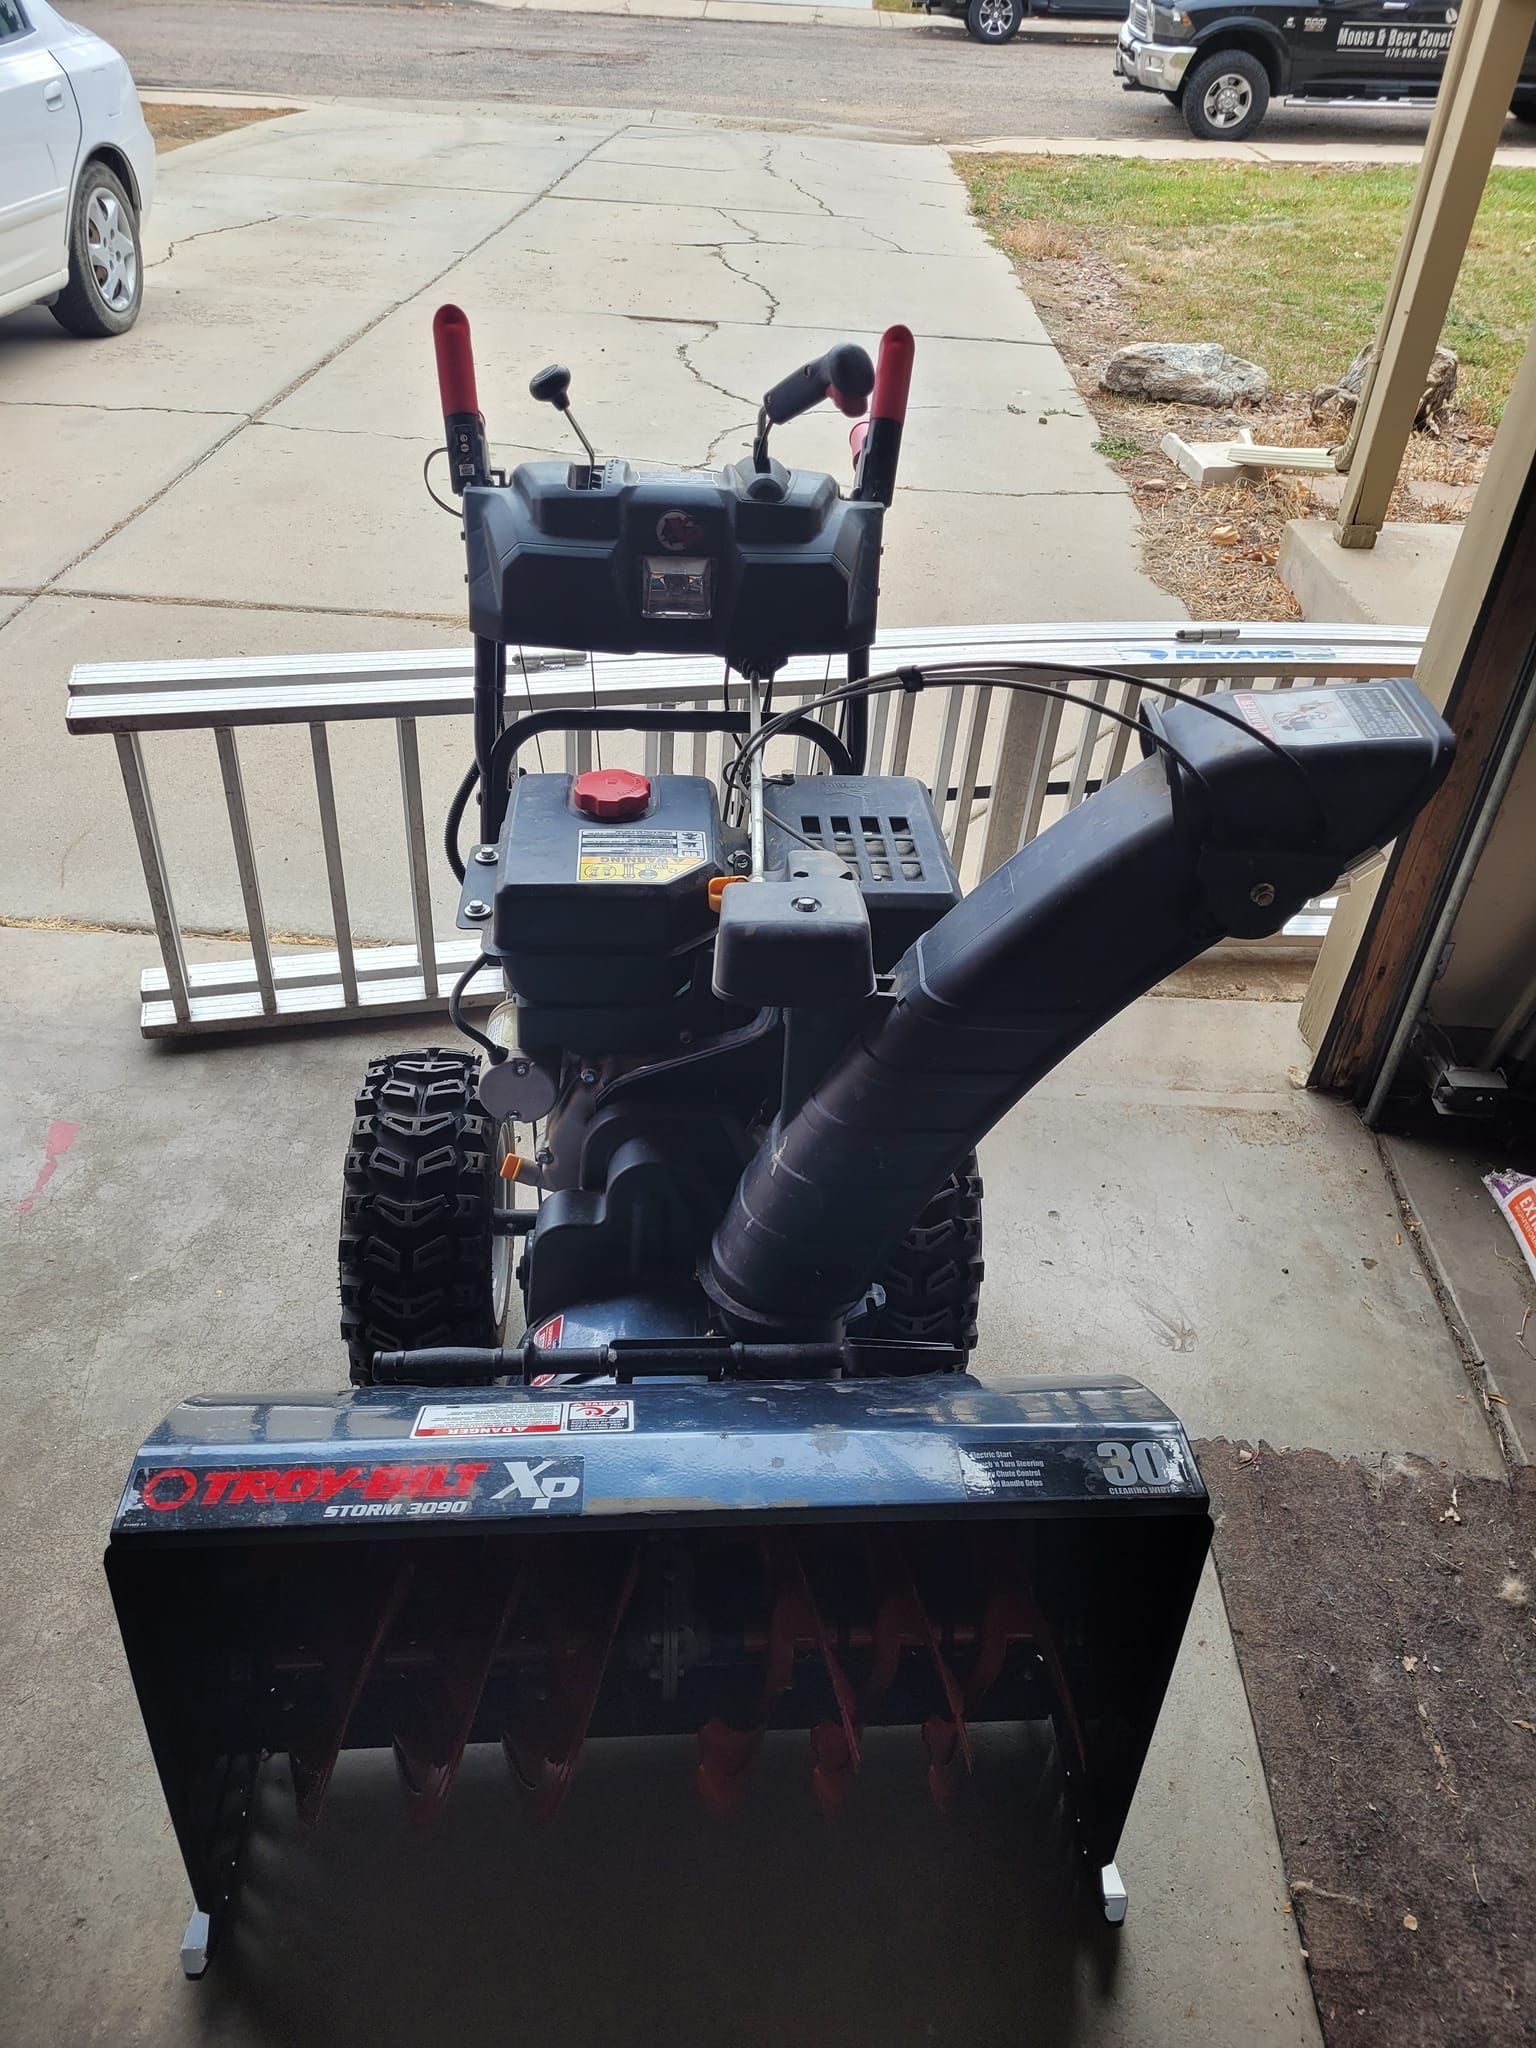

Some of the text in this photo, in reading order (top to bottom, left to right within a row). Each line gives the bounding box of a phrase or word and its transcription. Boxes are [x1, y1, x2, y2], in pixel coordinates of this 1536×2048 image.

[1336, 28, 1375, 46] Moose
[1376, 28, 1386, 46] &
[1387, 28, 1417, 47] Bear
[600, 856, 667, 864] WARNING
[448, 1427, 513, 1435] DANGER
[1096, 1441, 1172, 1487] 30
[996, 1469, 1016, 1477] Chute
[1016, 1469, 1041, 1477] Control
[200, 1463, 489, 1505] TROY-BILT
[1109, 1486, 1148, 1495] CLEARING
[323, 1500, 467, 1518] STORM 3090
